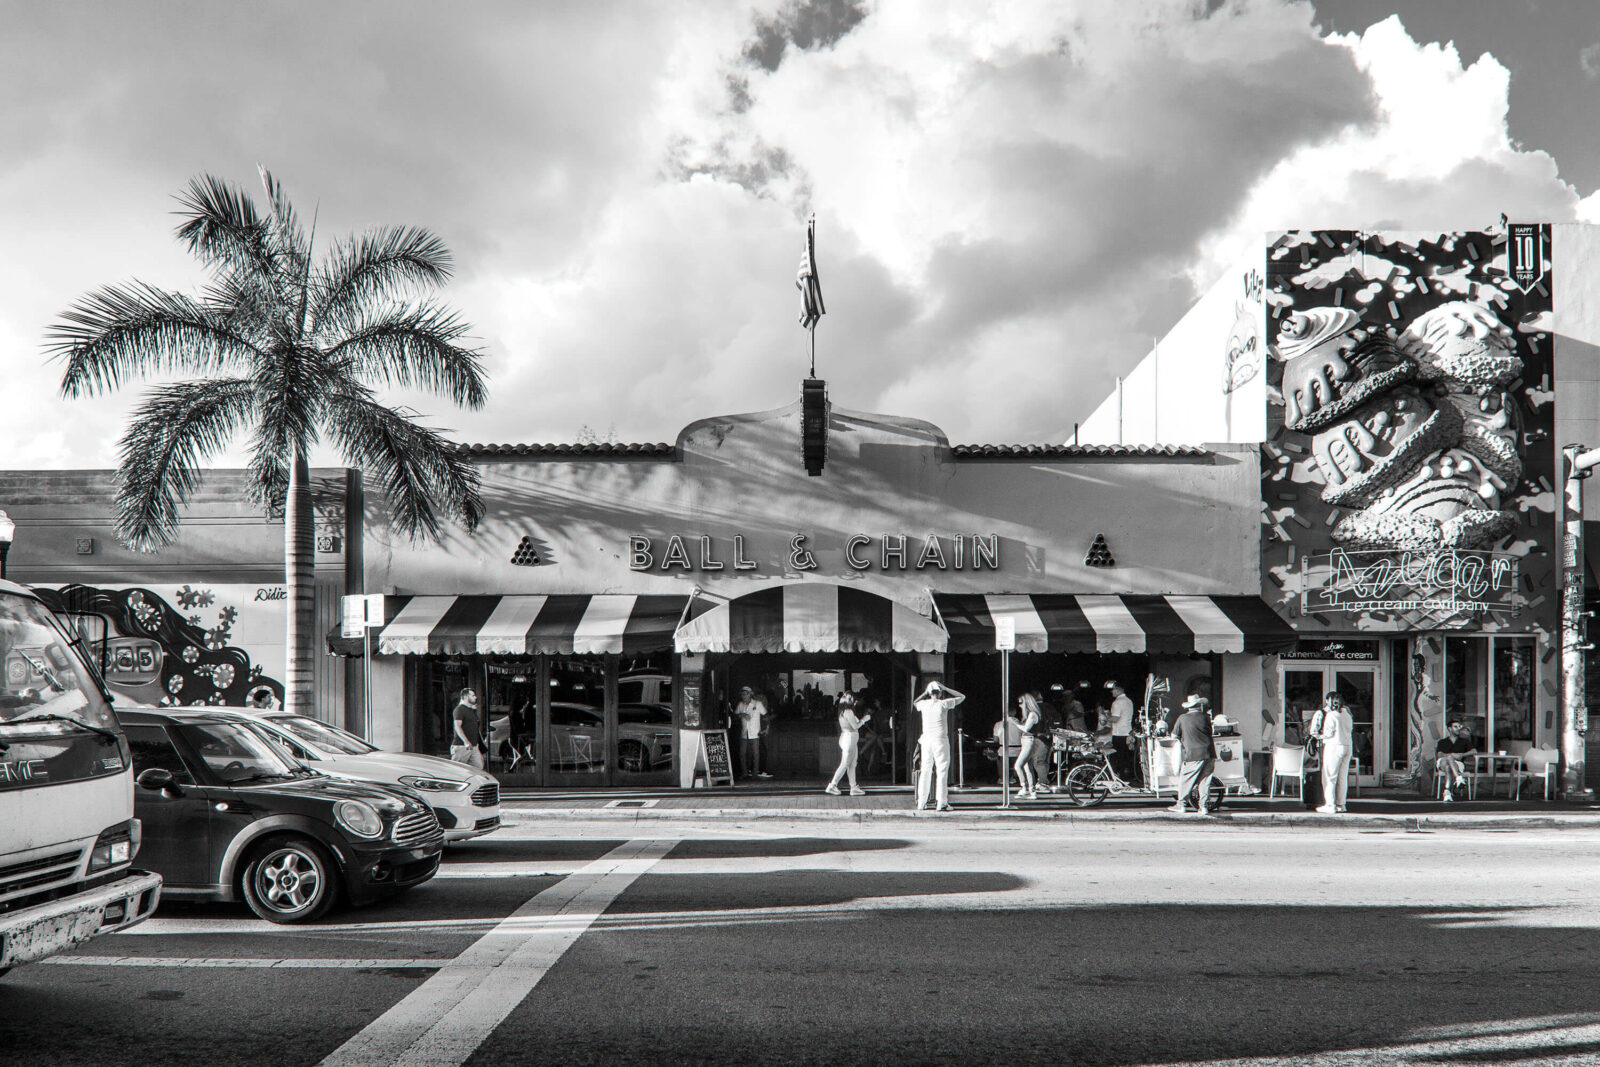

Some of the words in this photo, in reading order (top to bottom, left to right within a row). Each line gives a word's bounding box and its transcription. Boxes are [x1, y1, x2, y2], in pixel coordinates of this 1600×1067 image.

[1515, 236, 1533, 270] 10
[628, 534, 757, 571] BALL
[788, 534, 818, 571] &
[845, 533, 1001, 570] CHAIN
[1368, 600, 1416, 611] cream
[1423, 599, 1490, 614] company
[1334, 650, 1346, 660] ice
[1347, 651, 1373, 660] cream
